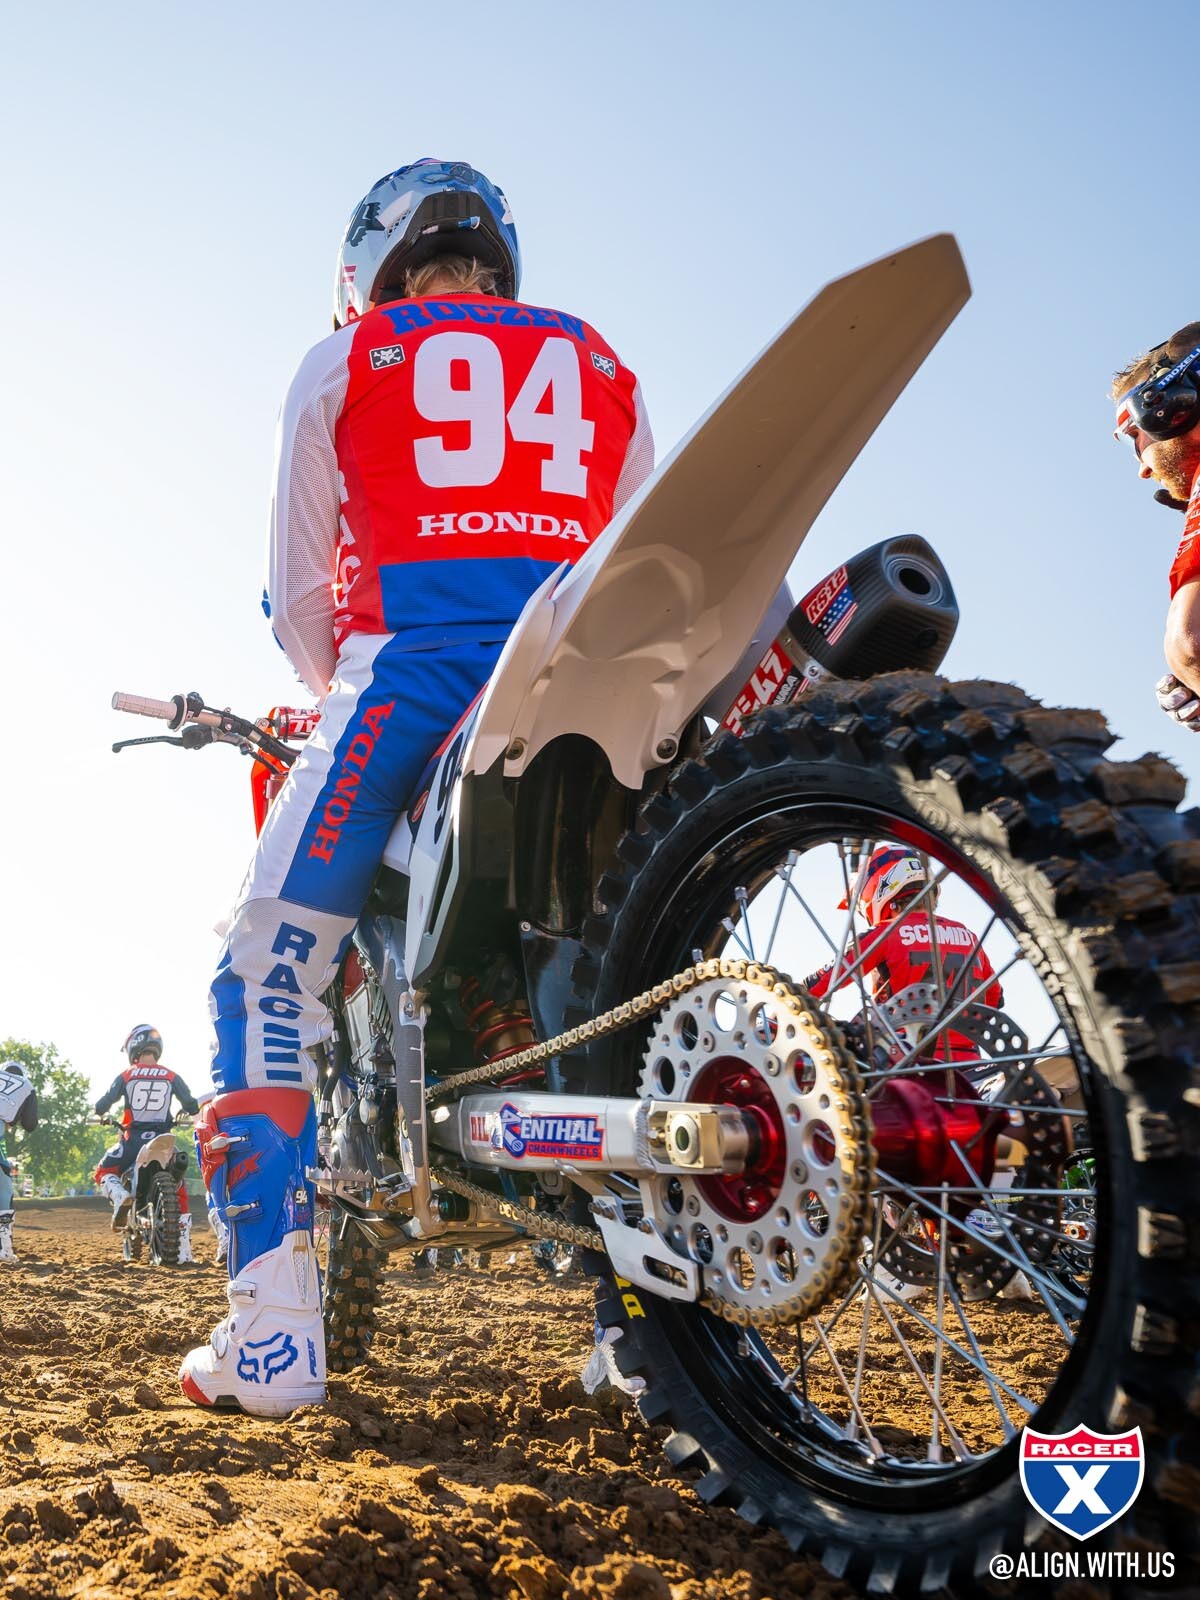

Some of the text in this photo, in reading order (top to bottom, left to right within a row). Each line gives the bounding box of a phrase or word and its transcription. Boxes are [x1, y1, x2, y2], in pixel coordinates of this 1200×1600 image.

[381, 301, 588, 341] ROCZEN
[412, 331, 596, 499] 94
[416, 511, 590, 543] HONDA
[307, 700, 396, 865] HONDA
[130, 1067, 168, 1077] HAND
[131, 1080, 169, 1112] 63
[528, 1143, 599, 1158] CHAINWHEELS
[295, 1189, 308, 1205] 94
